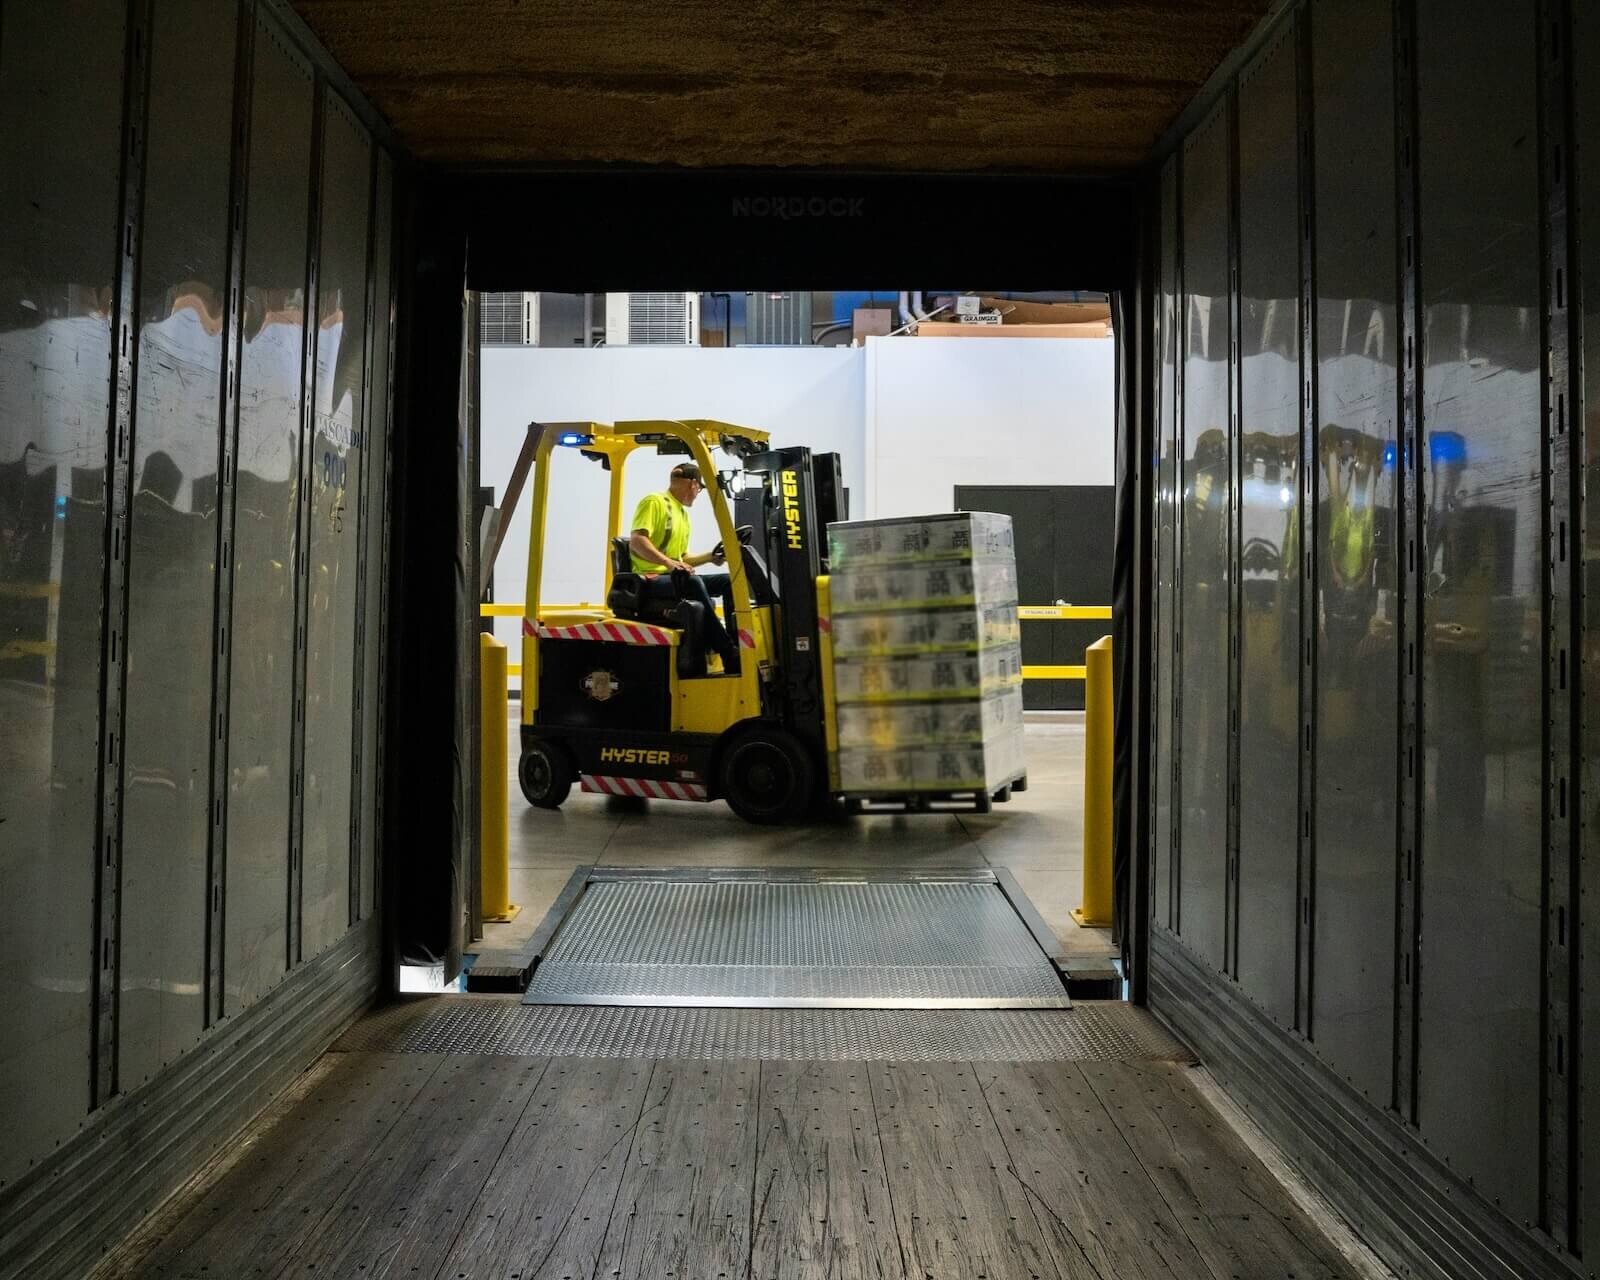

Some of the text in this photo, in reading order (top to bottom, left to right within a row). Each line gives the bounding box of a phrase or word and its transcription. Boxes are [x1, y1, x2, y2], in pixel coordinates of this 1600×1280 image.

[731, 196, 865, 220] NORDOCK
[781, 470, 802, 550] HYSTER
[601, 748, 670, 765] HYSTER
